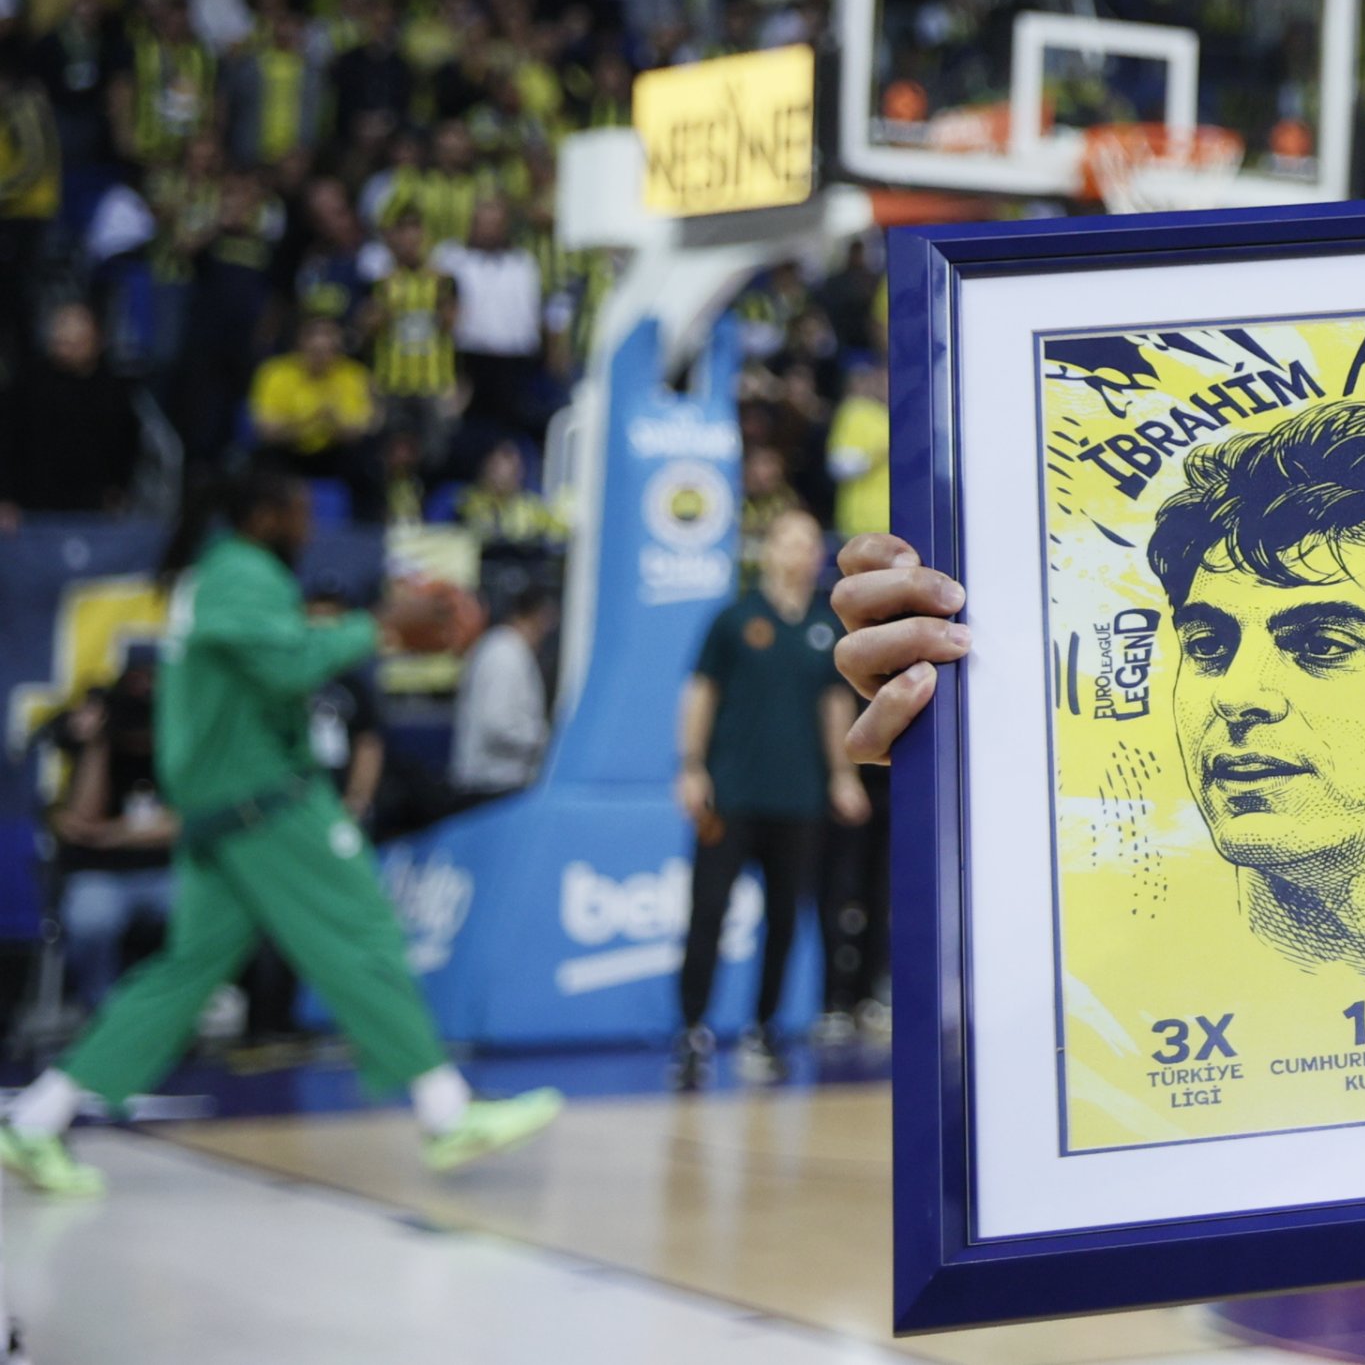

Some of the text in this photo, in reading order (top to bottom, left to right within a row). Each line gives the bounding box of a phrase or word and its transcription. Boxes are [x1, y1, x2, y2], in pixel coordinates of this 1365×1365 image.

[1076, 359, 1327, 502] İBRAHİM
[1093, 622, 1116, 720] EUROLEAGUE
[1113, 608, 1162, 722] LEGEND
[1146, 1062, 1245, 1088] TÜRKİYE
[1150, 1012, 1239, 1065] 3X
[1170, 1084, 1223, 1109] LİGİ
